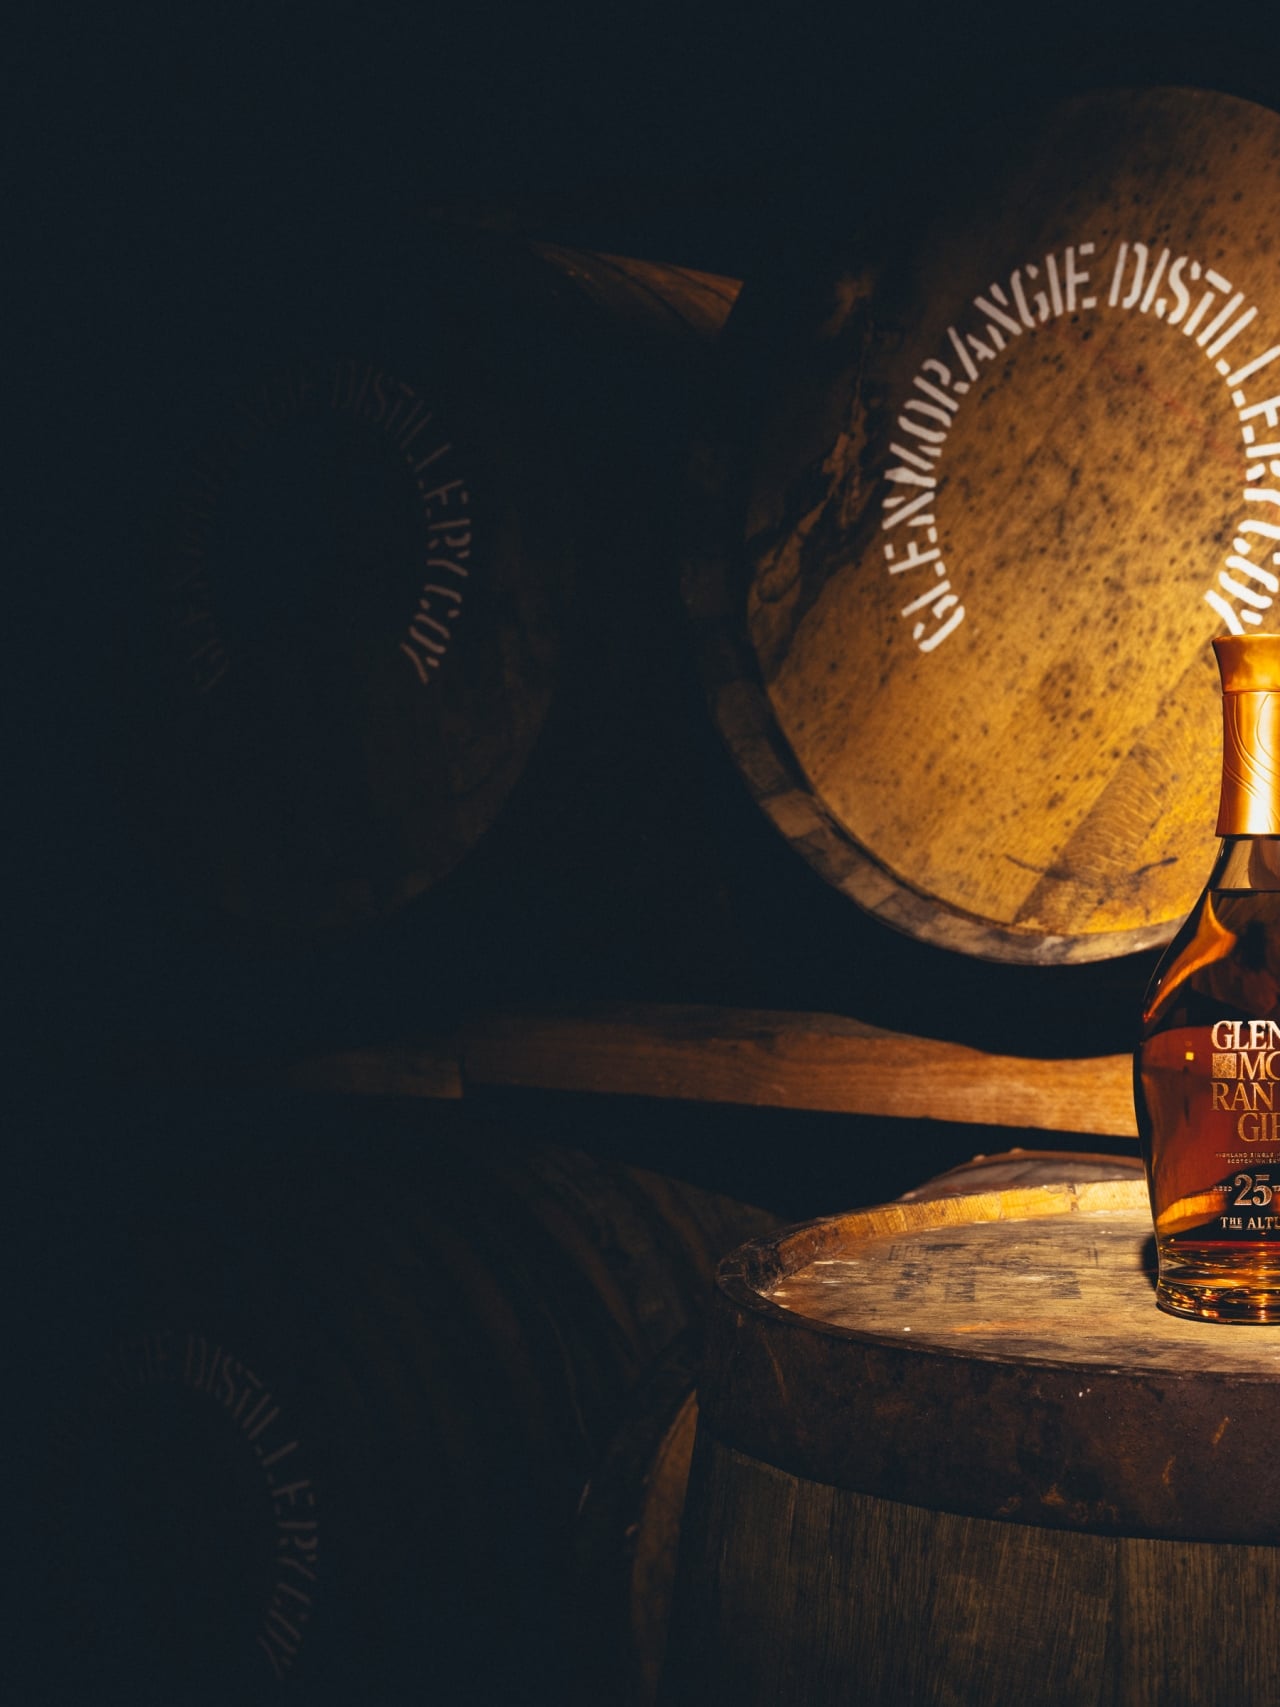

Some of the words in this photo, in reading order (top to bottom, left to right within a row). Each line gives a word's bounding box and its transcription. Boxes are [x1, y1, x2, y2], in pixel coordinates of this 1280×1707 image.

[882, 242, 1098, 652] GLENMORANGIE
[1211, 1082, 1275, 1111] RAN
[1233, 1173, 1273, 1206] 25
